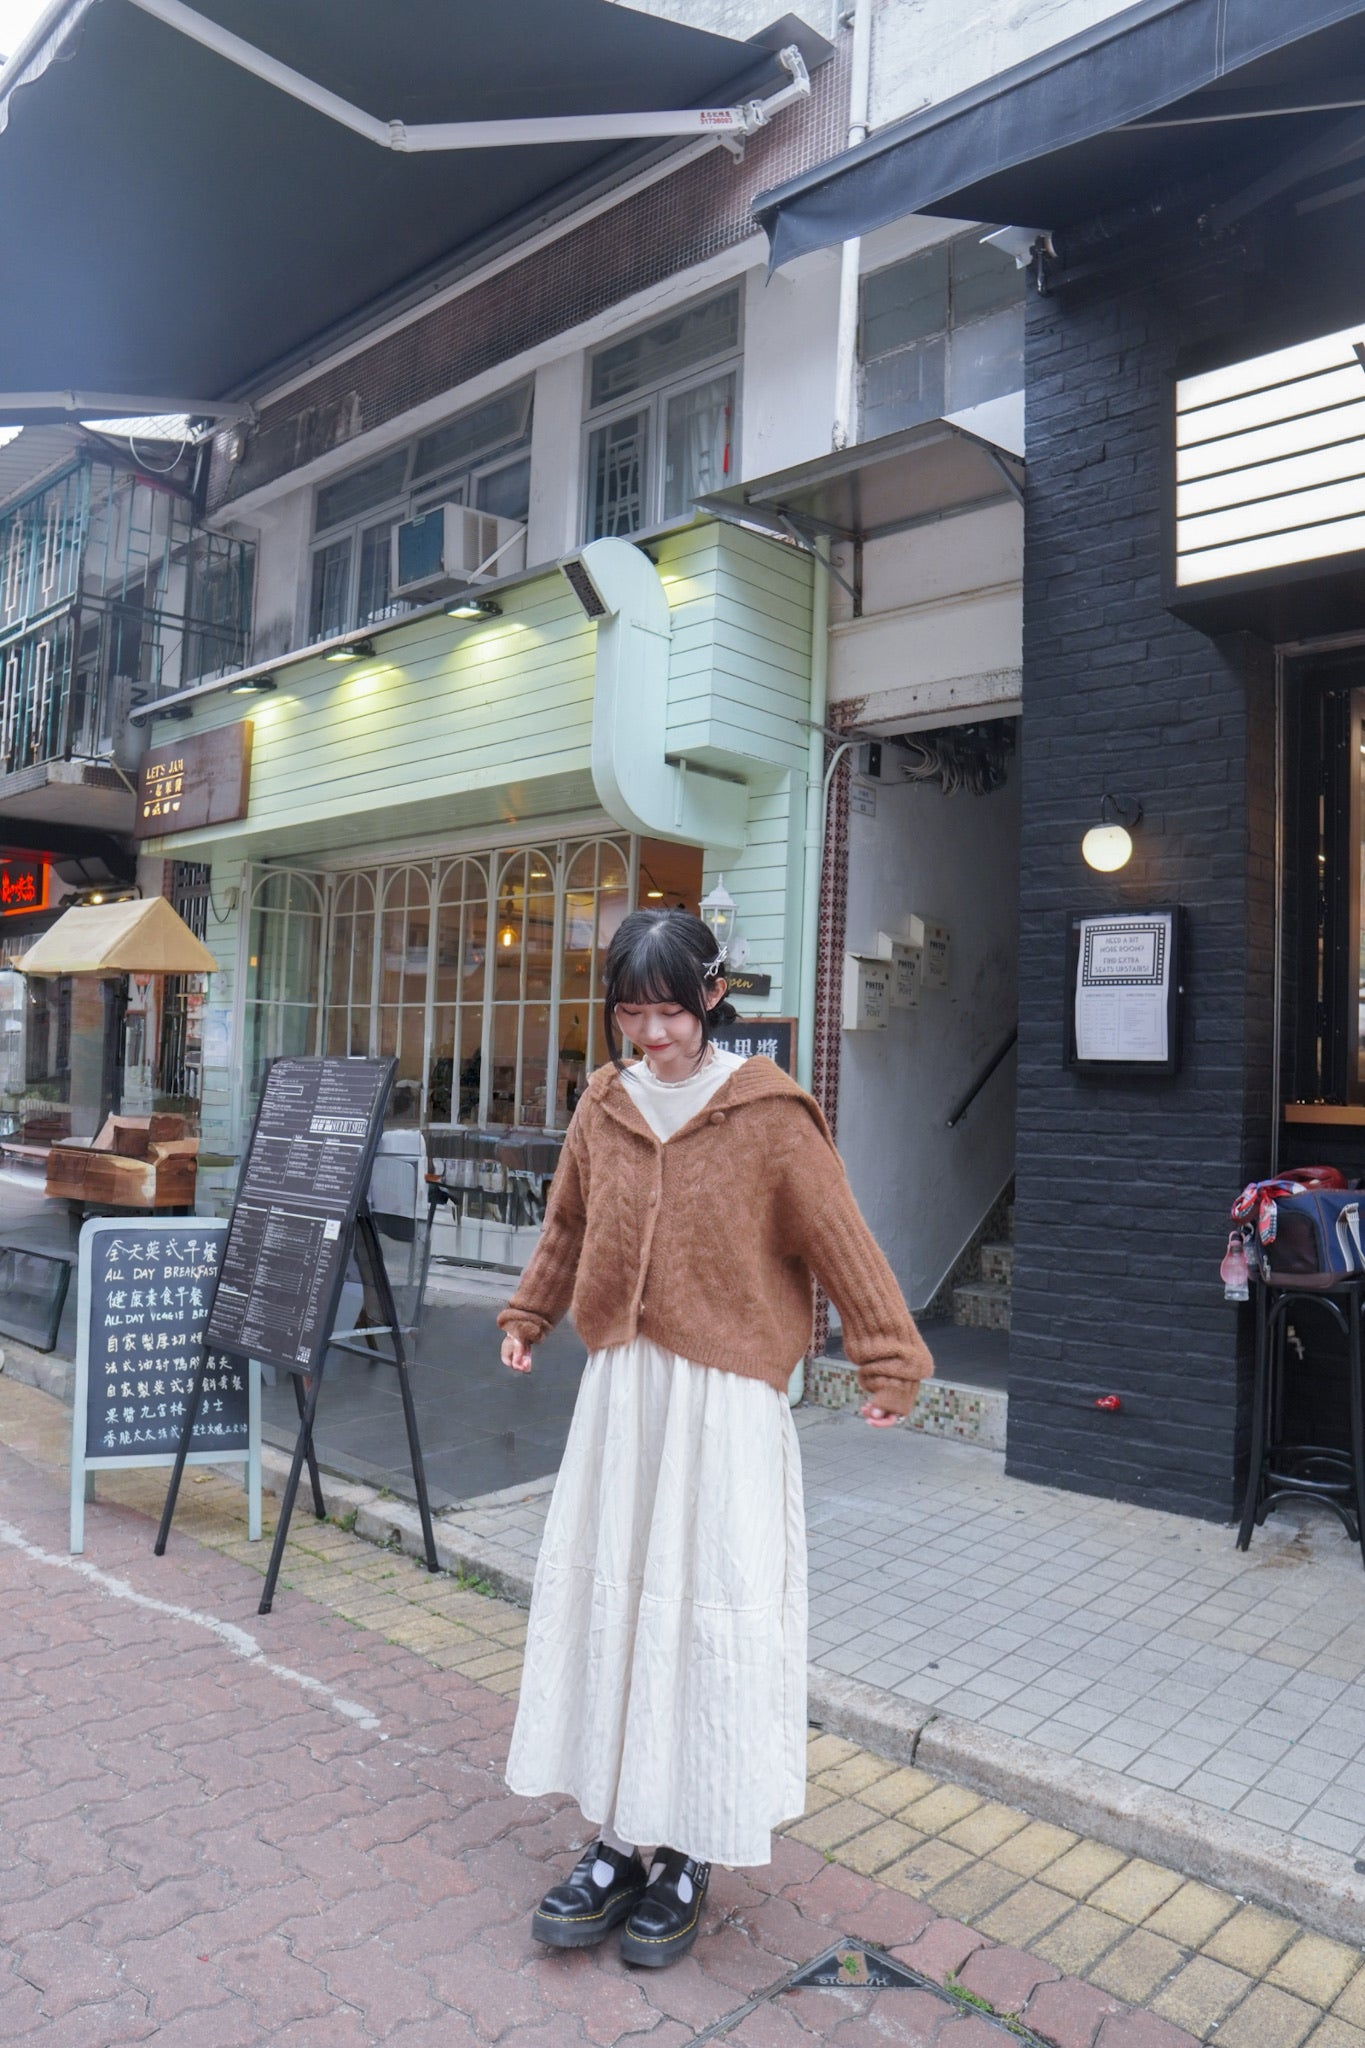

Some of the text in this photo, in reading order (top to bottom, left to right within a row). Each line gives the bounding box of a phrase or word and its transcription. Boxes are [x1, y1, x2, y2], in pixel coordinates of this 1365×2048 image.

[168, 758, 184, 773] JAM
[727, 978, 753, 989] pen
[105, 1238, 218, 1263] 全天英式早餐
[104, 1265, 219, 1283] ALL DAY BREAKFAST
[106, 1286, 203, 1309] 健康素食早餐
[104, 1314, 124, 1327] ALL
[125, 1313, 145, 1325] DAY
